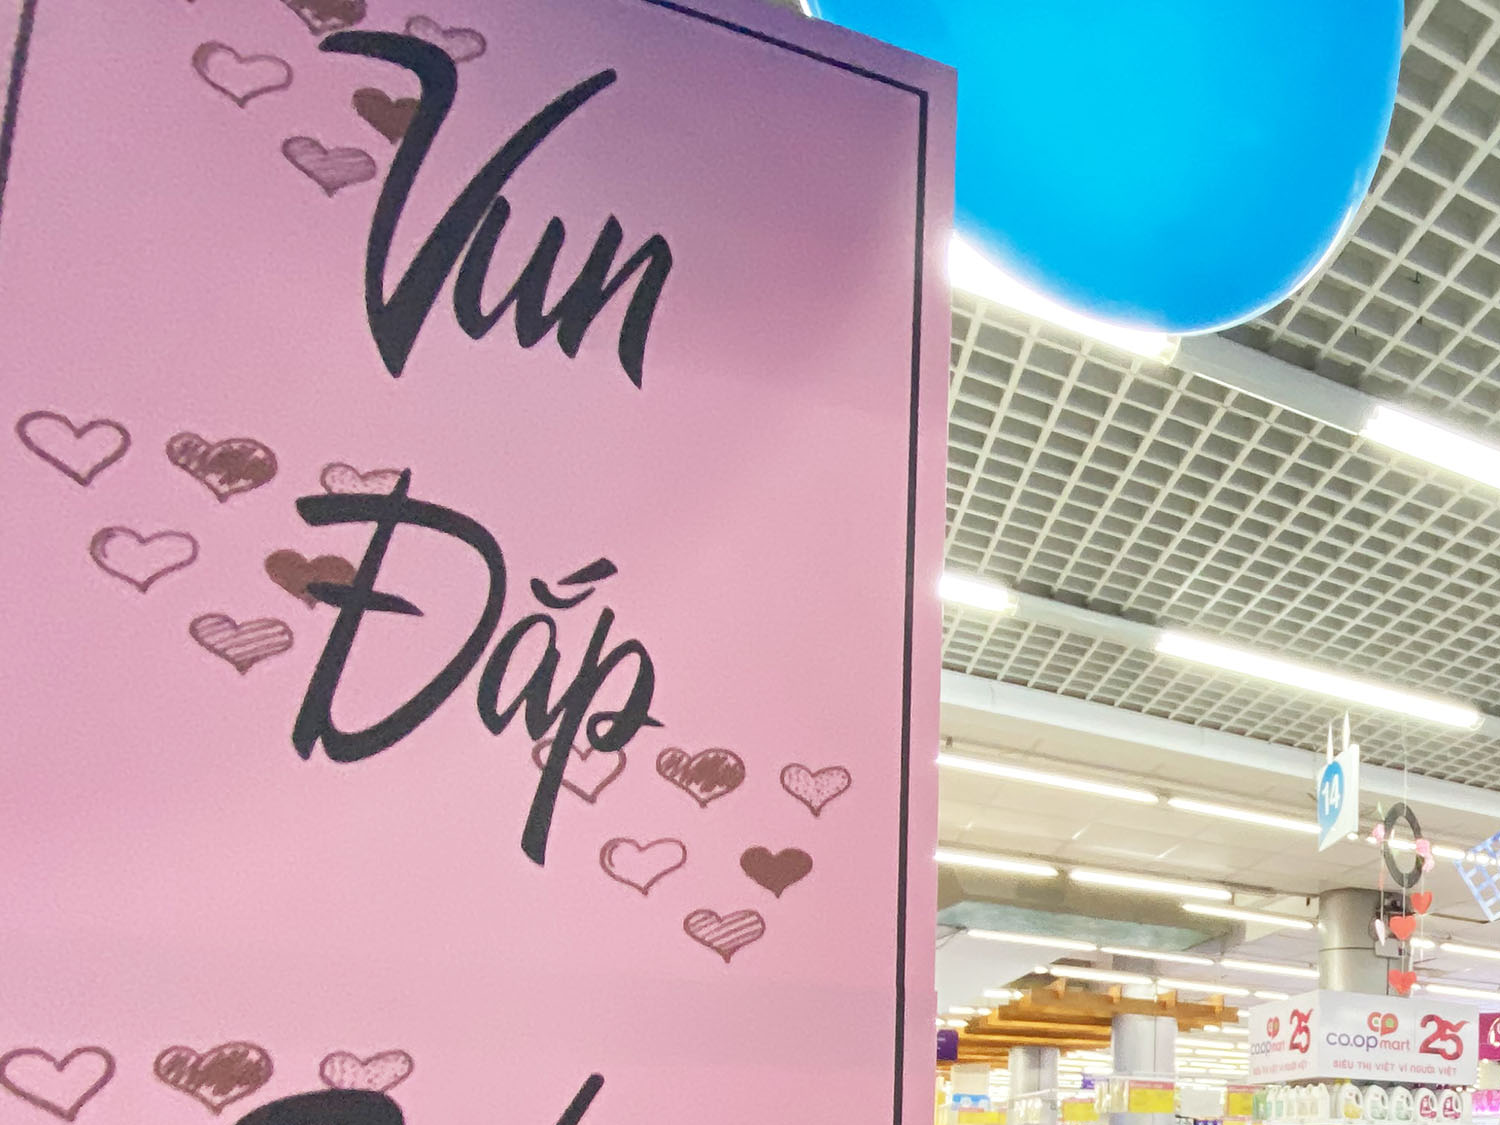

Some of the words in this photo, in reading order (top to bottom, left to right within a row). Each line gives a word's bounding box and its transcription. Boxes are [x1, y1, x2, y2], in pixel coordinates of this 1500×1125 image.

[319, 30, 674, 389] Vun
[291, 469, 666, 865] Đắp
[1321, 782, 1341, 817] 14
[1419, 1013, 1471, 1061] 25
